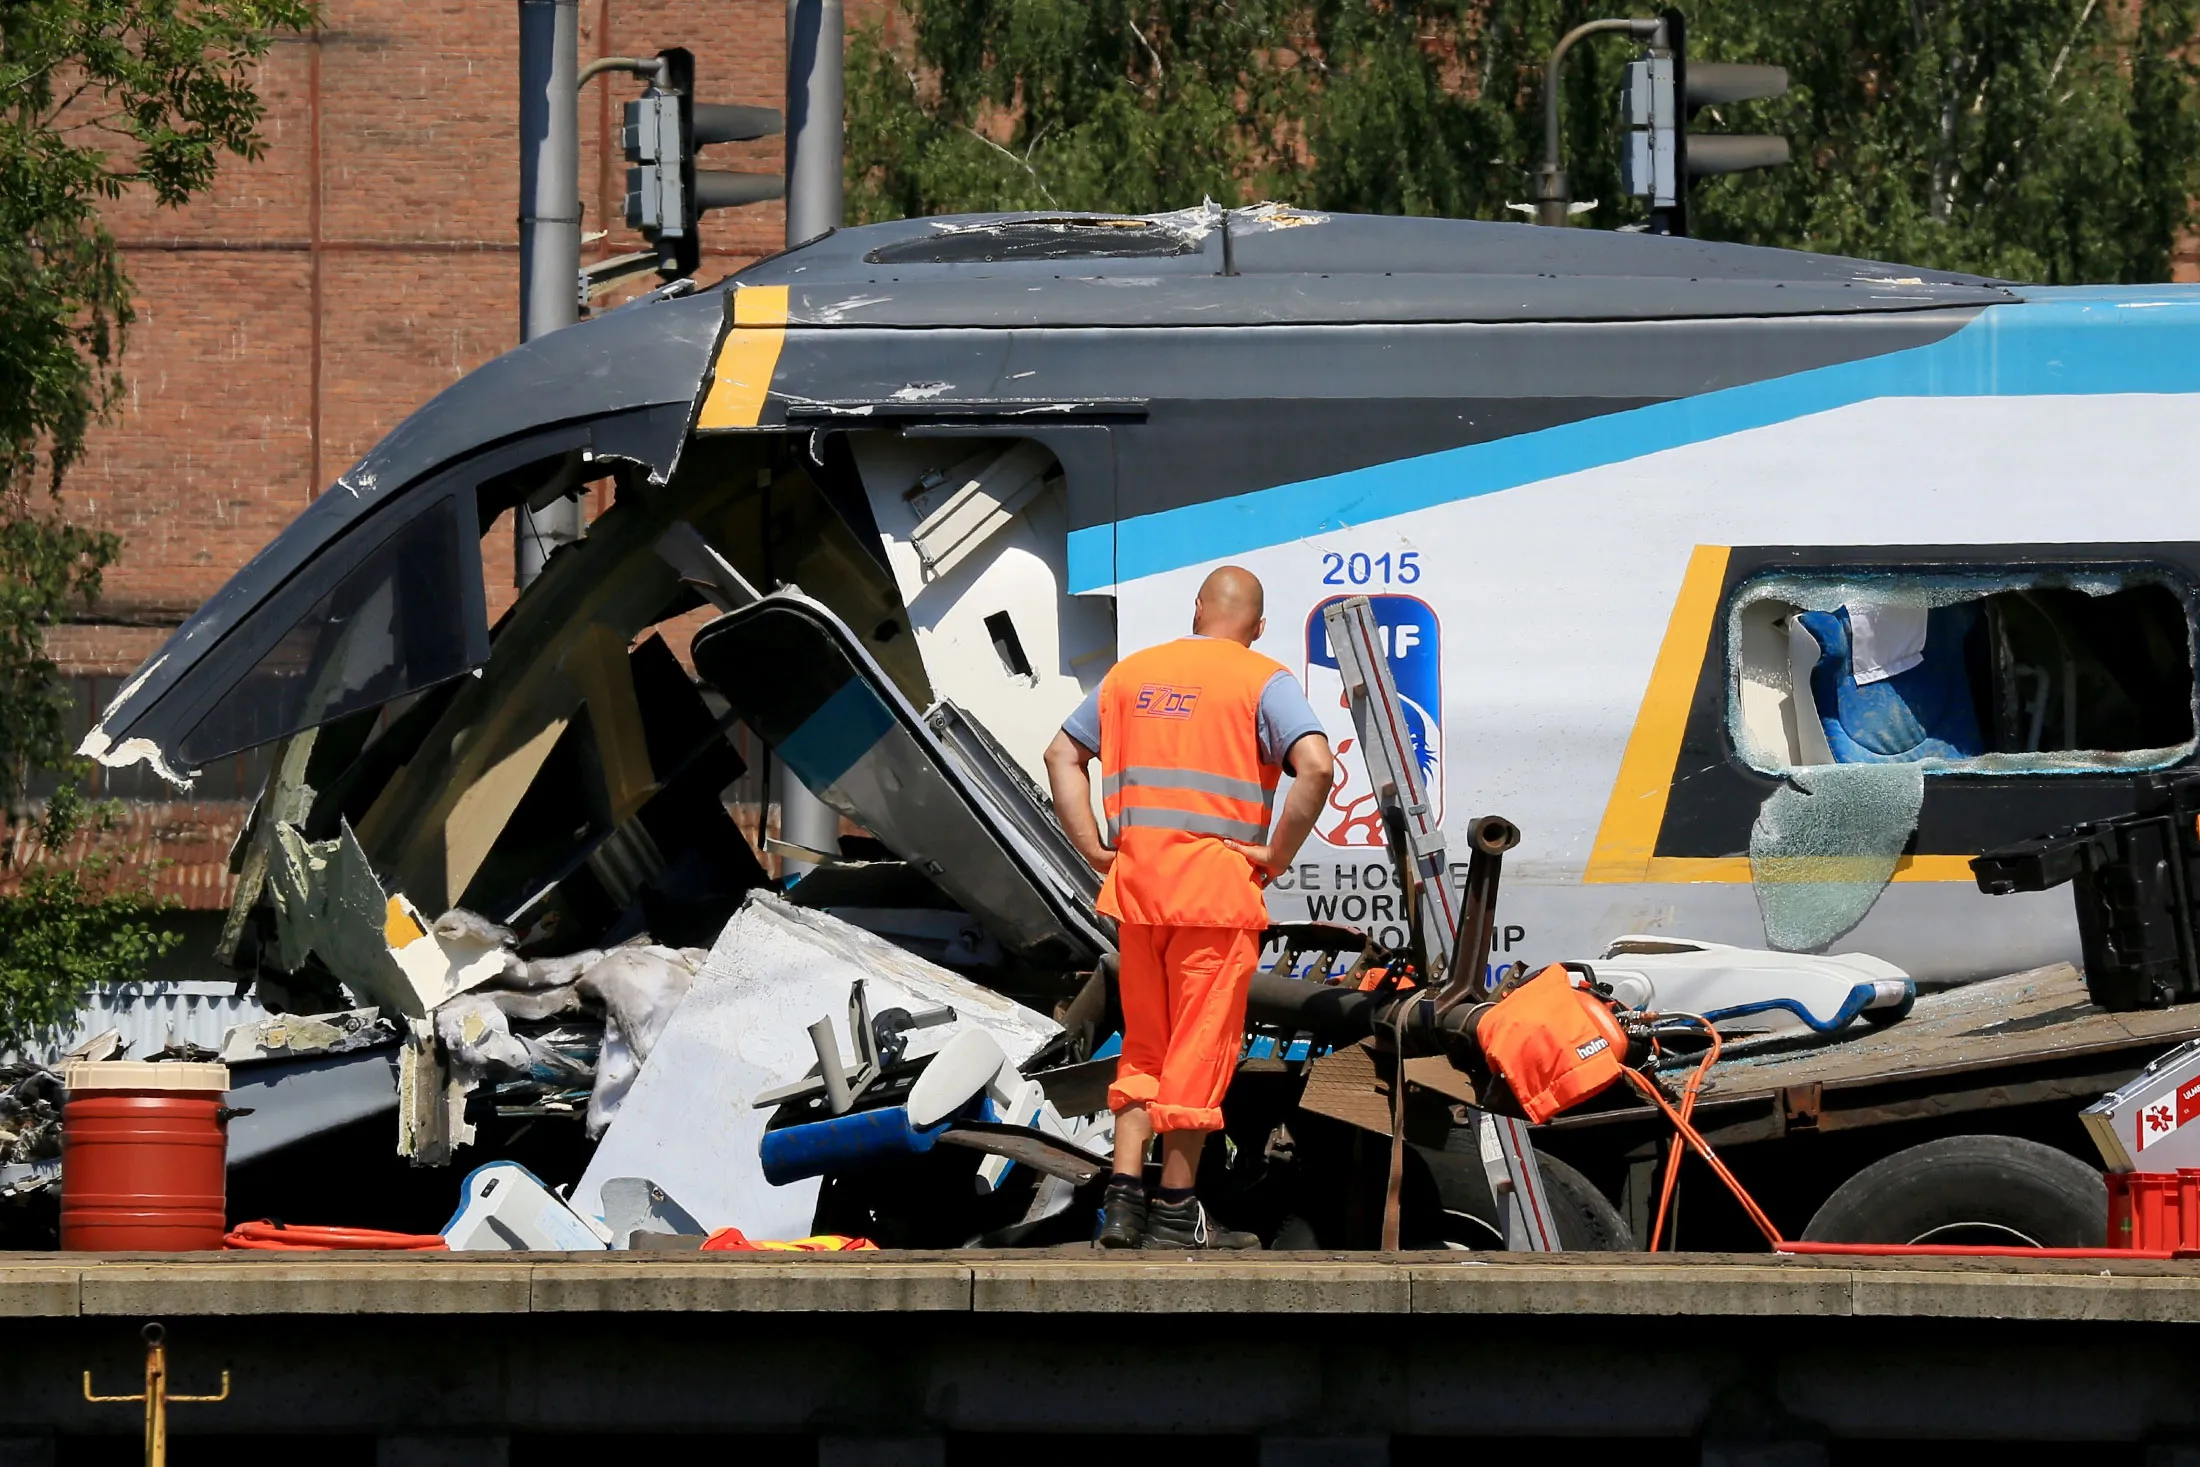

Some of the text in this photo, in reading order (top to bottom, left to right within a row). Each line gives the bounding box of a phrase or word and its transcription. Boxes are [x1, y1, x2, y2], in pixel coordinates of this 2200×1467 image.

[1322, 552, 1420, 584] 2015
[1272, 864, 1320, 890] CE
[1306, 894, 1409, 922] WORL
[1576, 1038, 1609, 1059] holm
